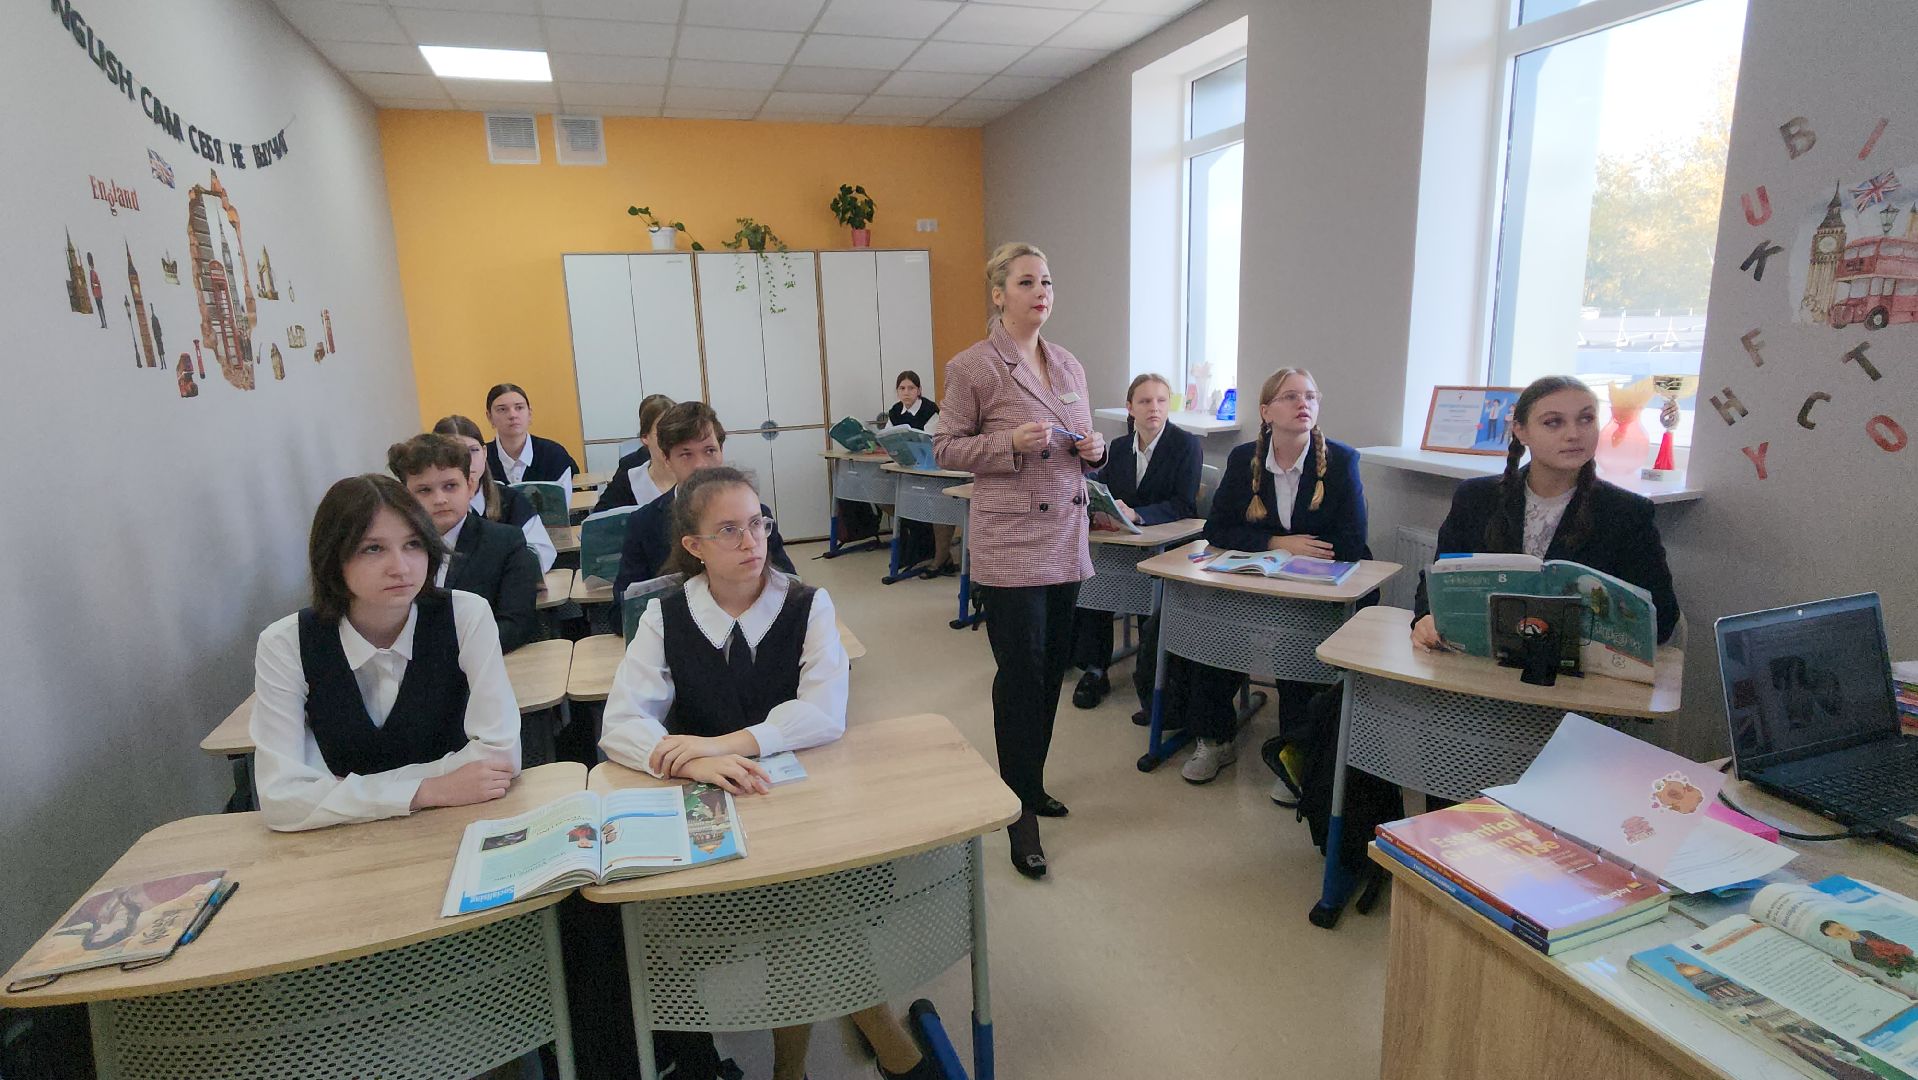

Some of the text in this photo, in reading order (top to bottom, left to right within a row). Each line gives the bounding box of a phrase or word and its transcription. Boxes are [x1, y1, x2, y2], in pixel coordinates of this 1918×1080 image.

[141, 86, 185, 142] САМ
[229, 142, 247, 169] НЕ
[1779, 116, 1817, 160] B
[88, 174, 141, 217] England
[1740, 185, 1773, 227] U
[1740, 239, 1785, 282] K
[1740, 327, 1766, 368] F
[1841, 340, 1883, 382] T
[1709, 386, 1749, 427] H
[1796, 390, 1832, 431] C
[1865, 414, 1908, 453] O
[1741, 441, 1769, 481] Y
[1430, 816, 1523, 849] Essential
[1441, 829, 1540, 861] Grammar
[1516, 840, 1561, 857] Use
